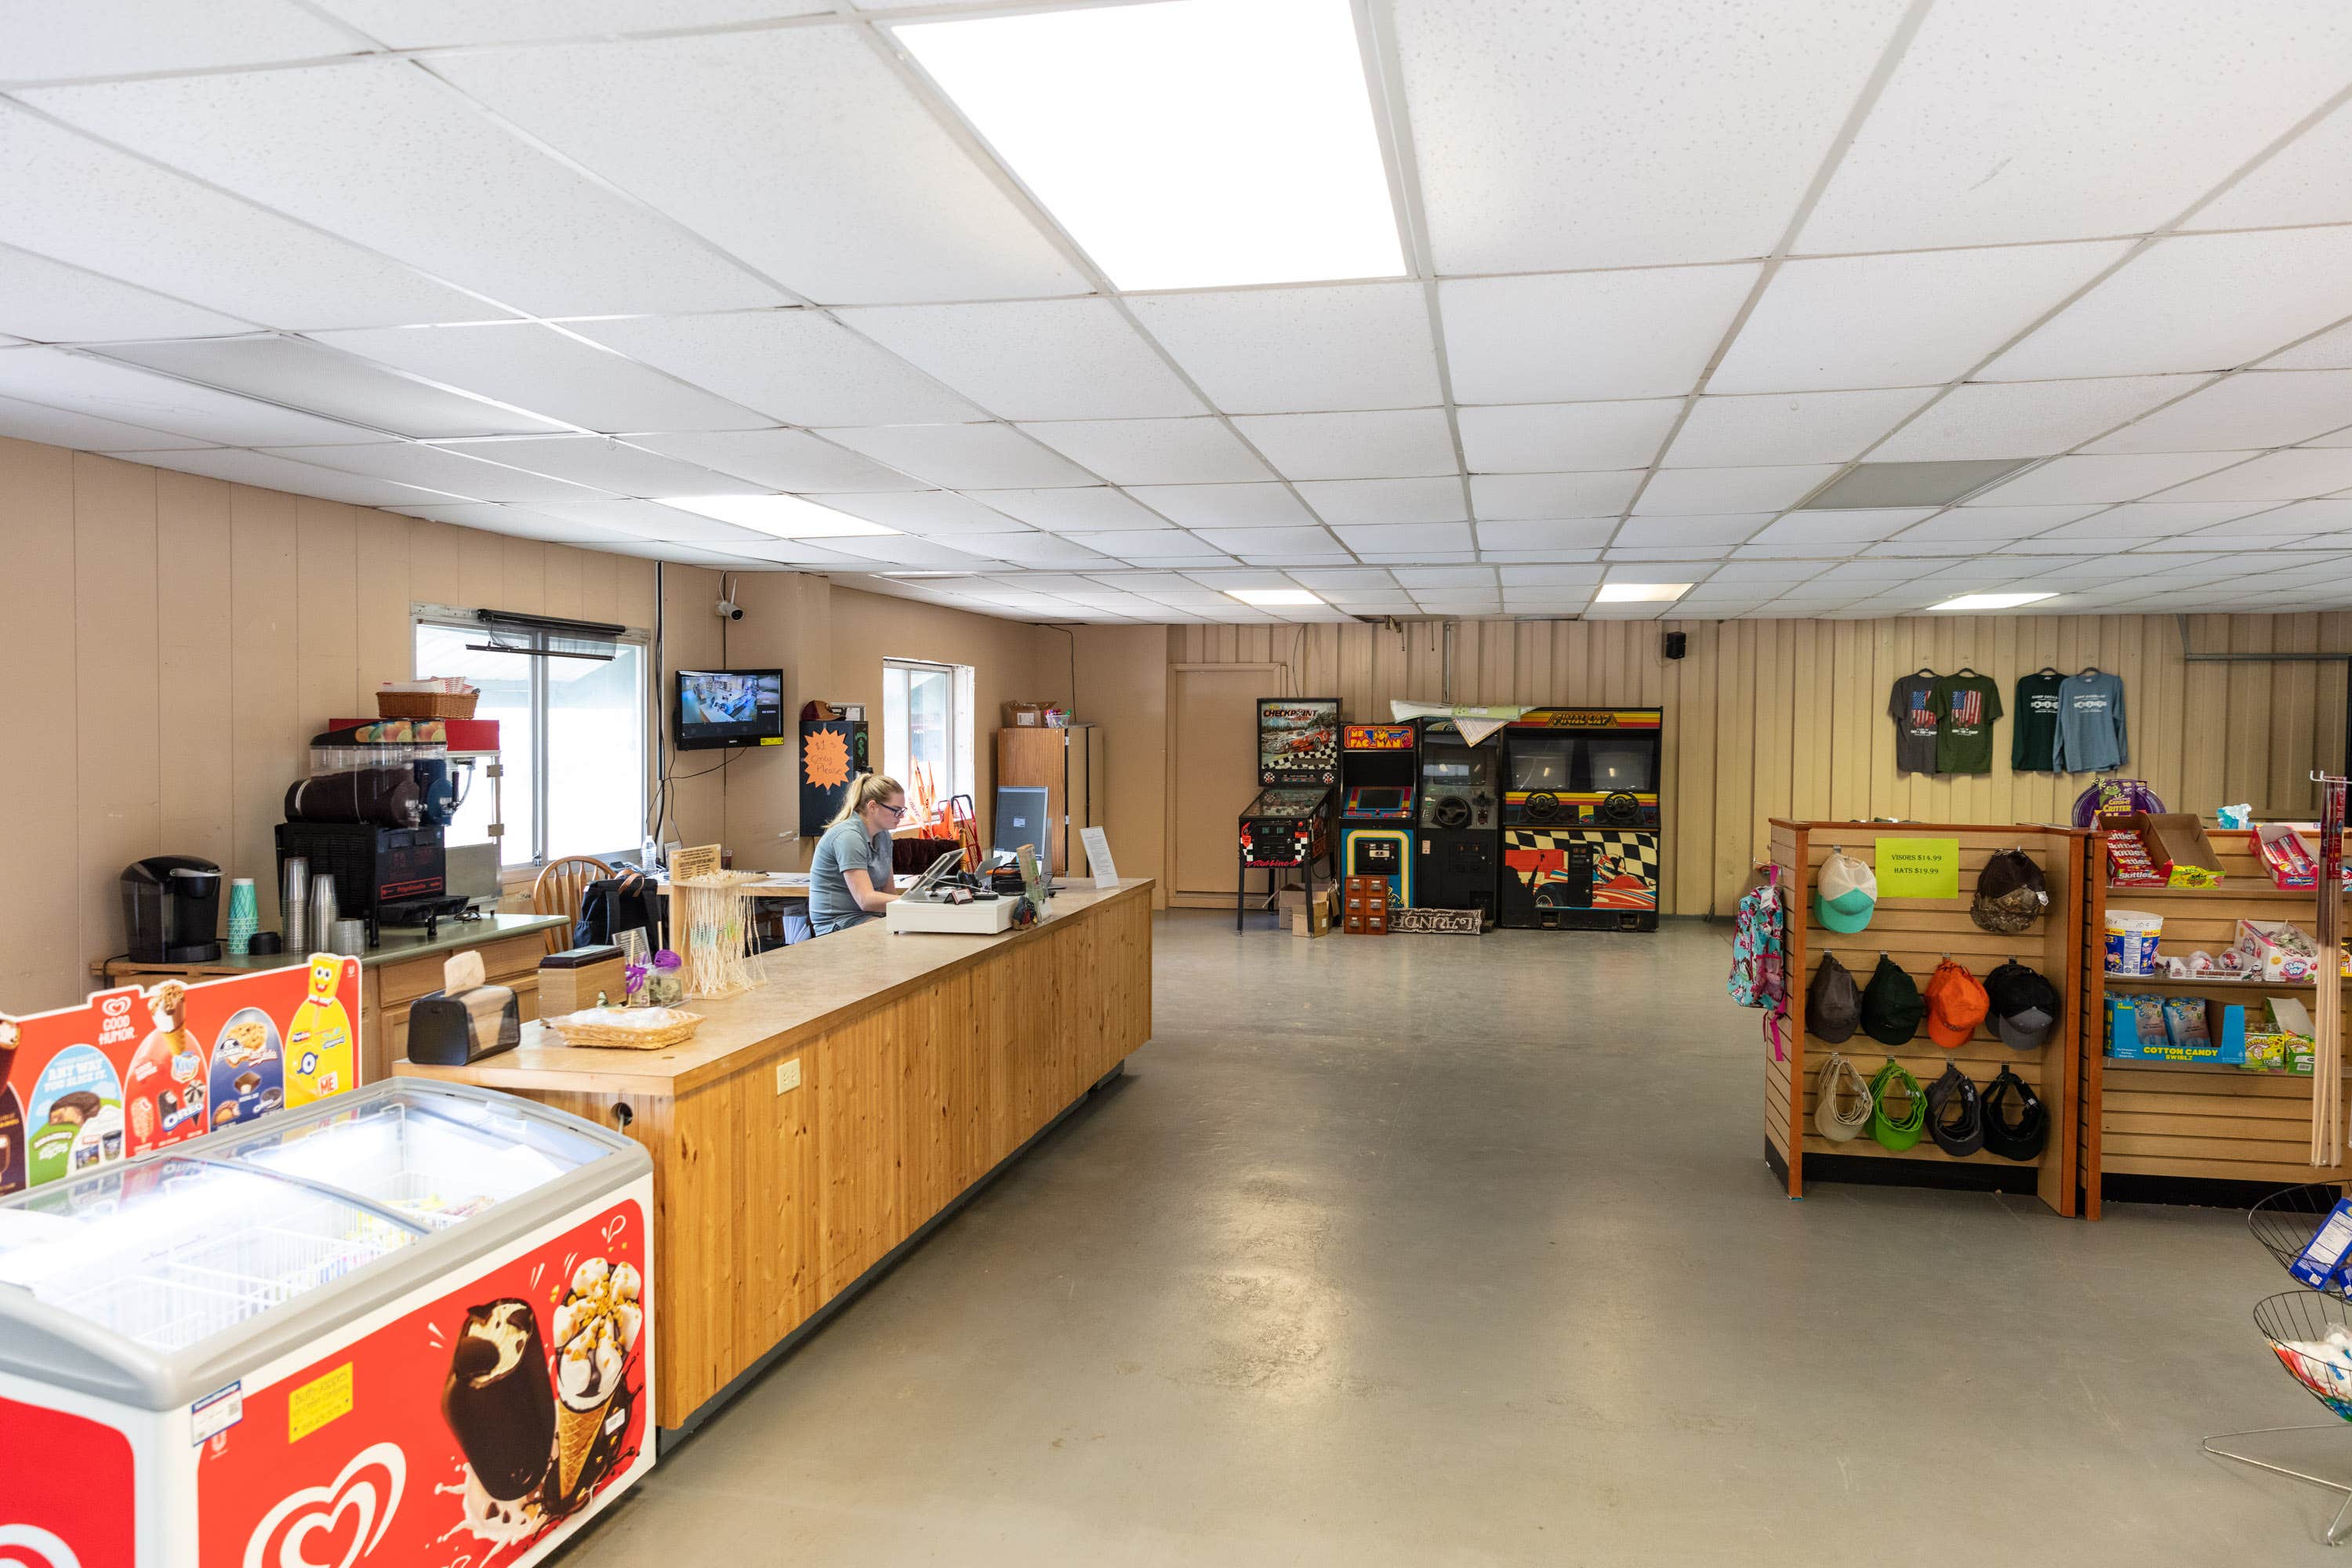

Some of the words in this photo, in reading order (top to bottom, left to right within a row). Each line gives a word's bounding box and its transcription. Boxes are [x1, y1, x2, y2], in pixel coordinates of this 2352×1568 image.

[1350, 738, 1402, 748] PAC-MAN
[816, 763, 842, 775] Please
[1390, 916, 1472, 931] LAUNDR
[103, 1014, 131, 1032] GOOD
[98, 1026, 136, 1046] HUMOR
[2143, 1046, 2183, 1054] COTTON
[2185, 1047, 2218, 1057] CANDY
[163, 1103, 204, 1131] OREO
